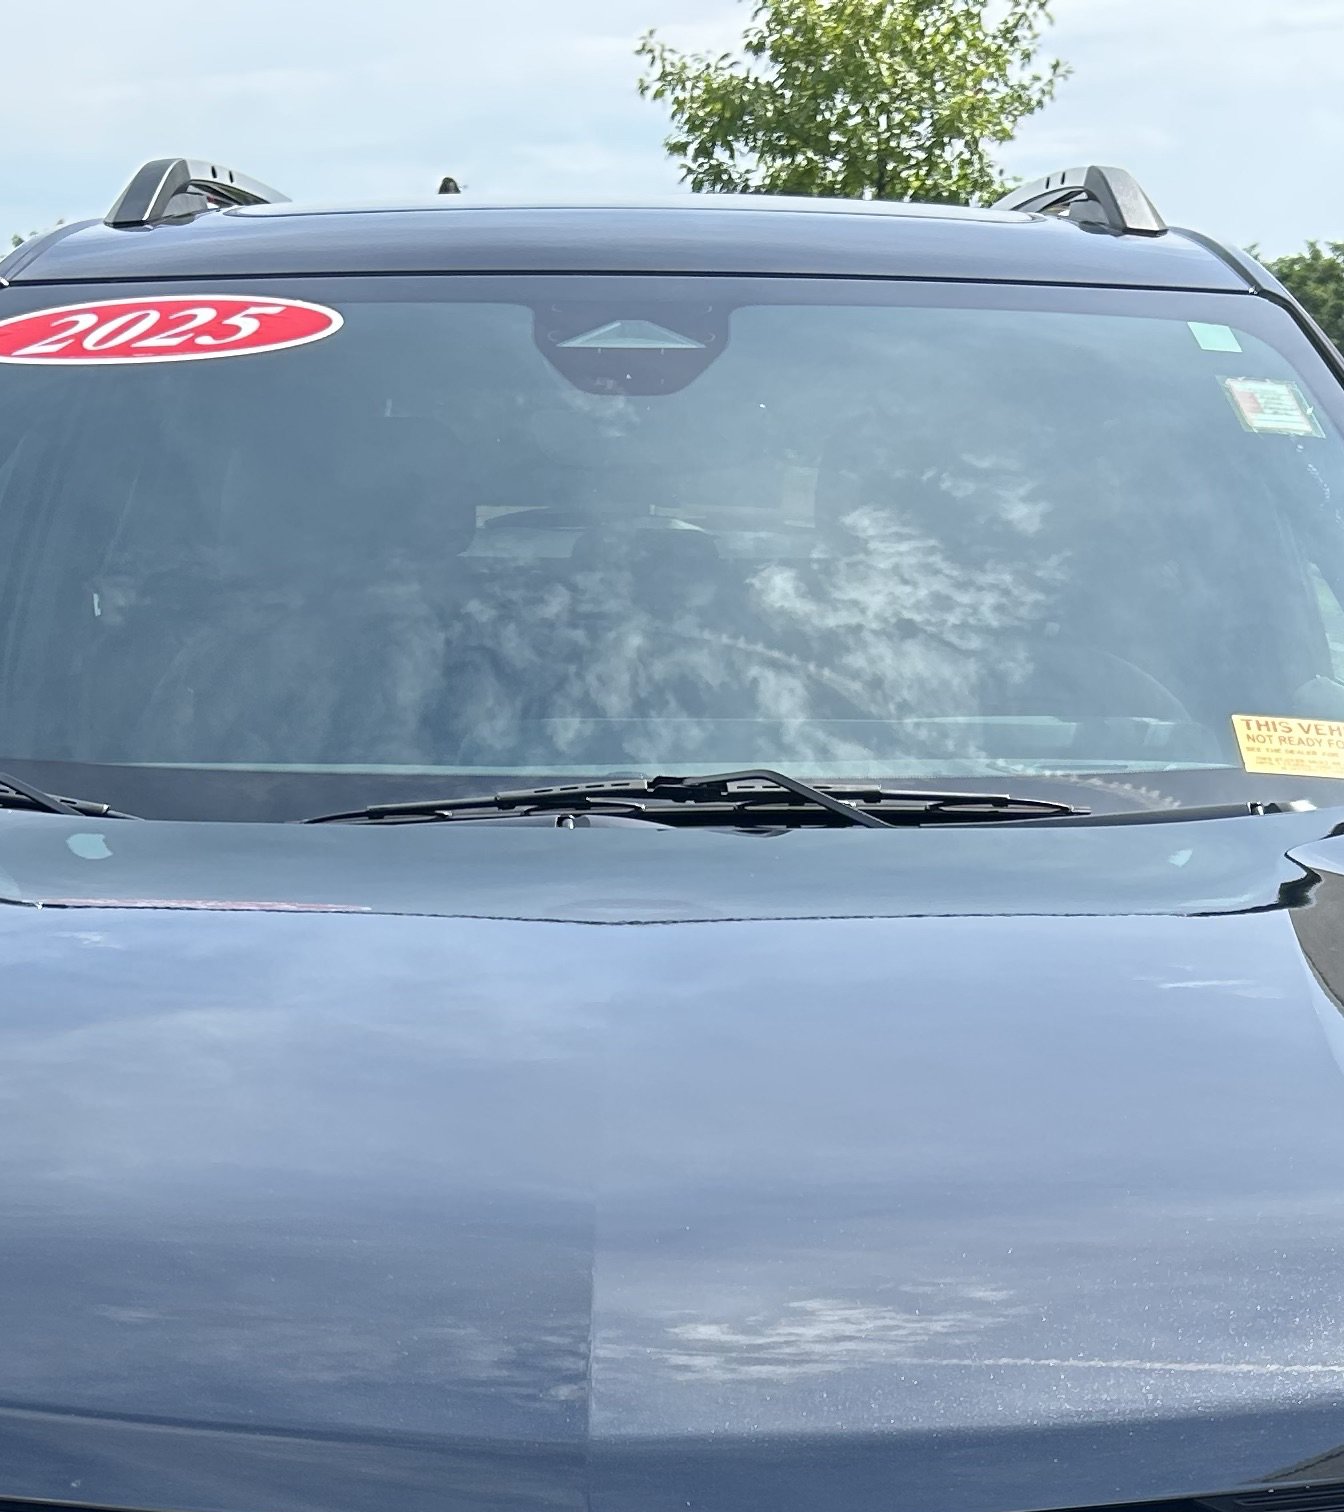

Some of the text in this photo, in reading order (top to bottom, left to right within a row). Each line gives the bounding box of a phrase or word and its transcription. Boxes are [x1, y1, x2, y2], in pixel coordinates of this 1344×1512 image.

[11, 306, 288, 356] 2025
[1241, 719, 1293, 733] THIS
[1246, 734, 1274, 745] NOT
[1278, 735, 1323, 748] READY
